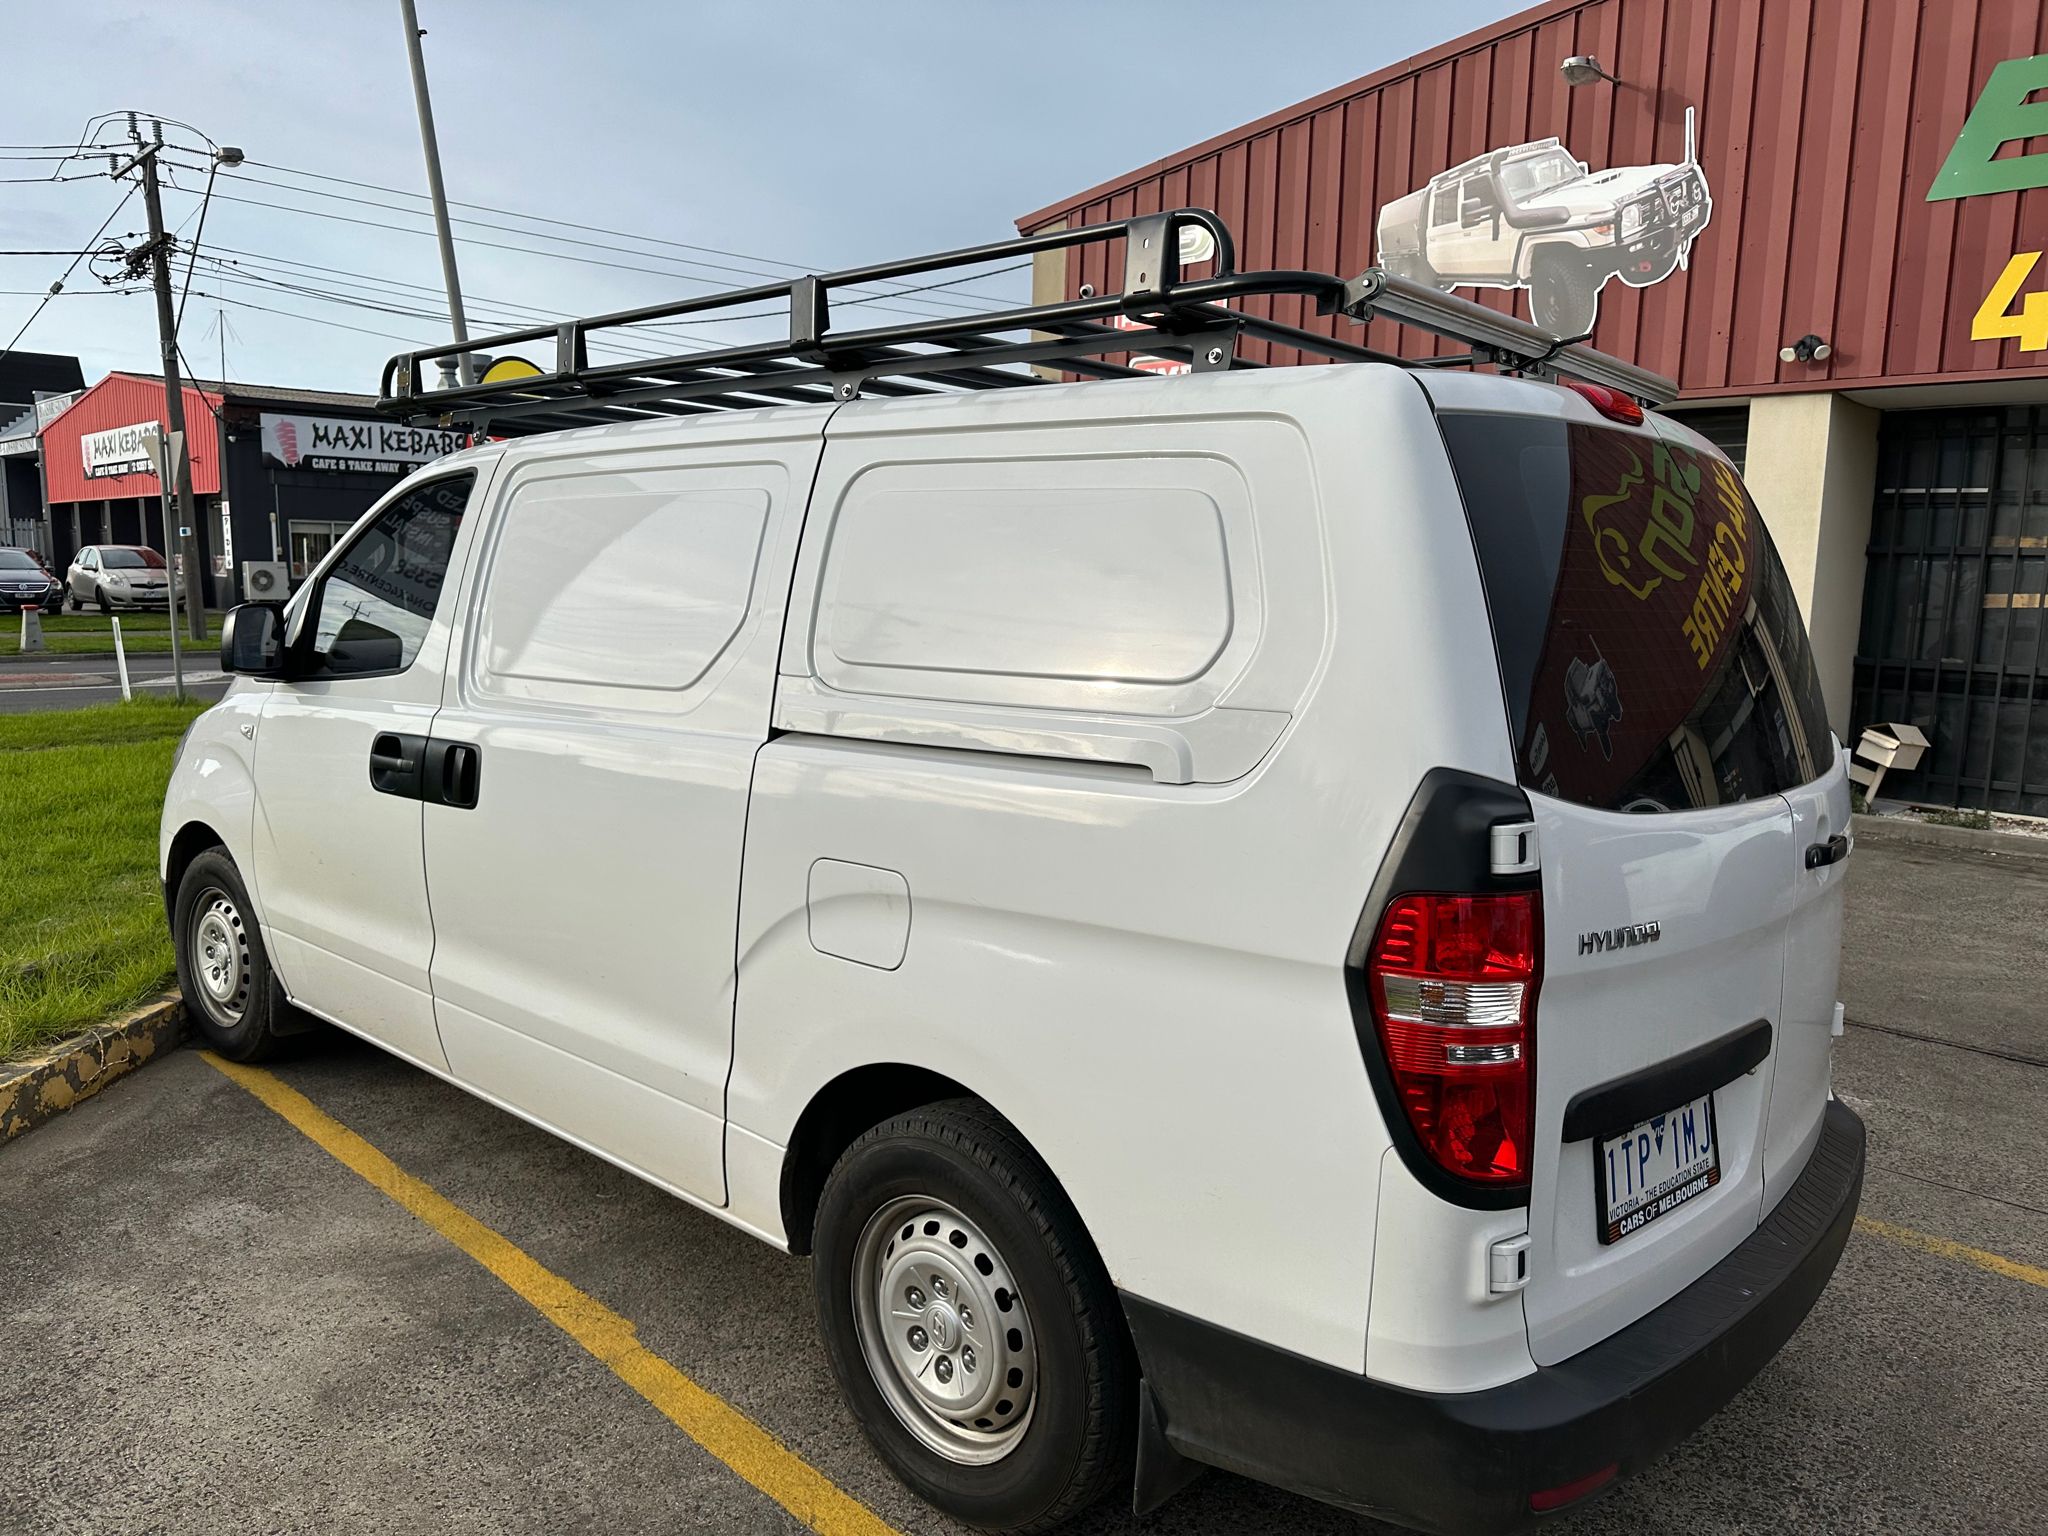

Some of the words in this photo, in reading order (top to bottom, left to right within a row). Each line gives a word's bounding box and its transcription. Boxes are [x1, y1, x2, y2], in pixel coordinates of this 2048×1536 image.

[94, 432, 117, 459] MAXI
[312, 422, 372, 451] MAXI
[312, 458, 337, 470] CAFE
[338, 459, 346, 470] &
[347, 460, 373, 472] TAKE
[374, 462, 400, 473] AWAY
[1578, 919, 1661, 956] HYUNDAI
[1609, 1196, 1640, 1221] VICTORIA
[1645, 1185, 1657, 1200] THE
[1658, 1166, 1692, 1193] EDUCATION
[1692, 1157, 1710, 1175] STATE
[1620, 1211, 1645, 1235] CARS
[1645, 1203, 1658, 1221] OF
[1658, 1174, 1709, 1214] MELBOURNE
